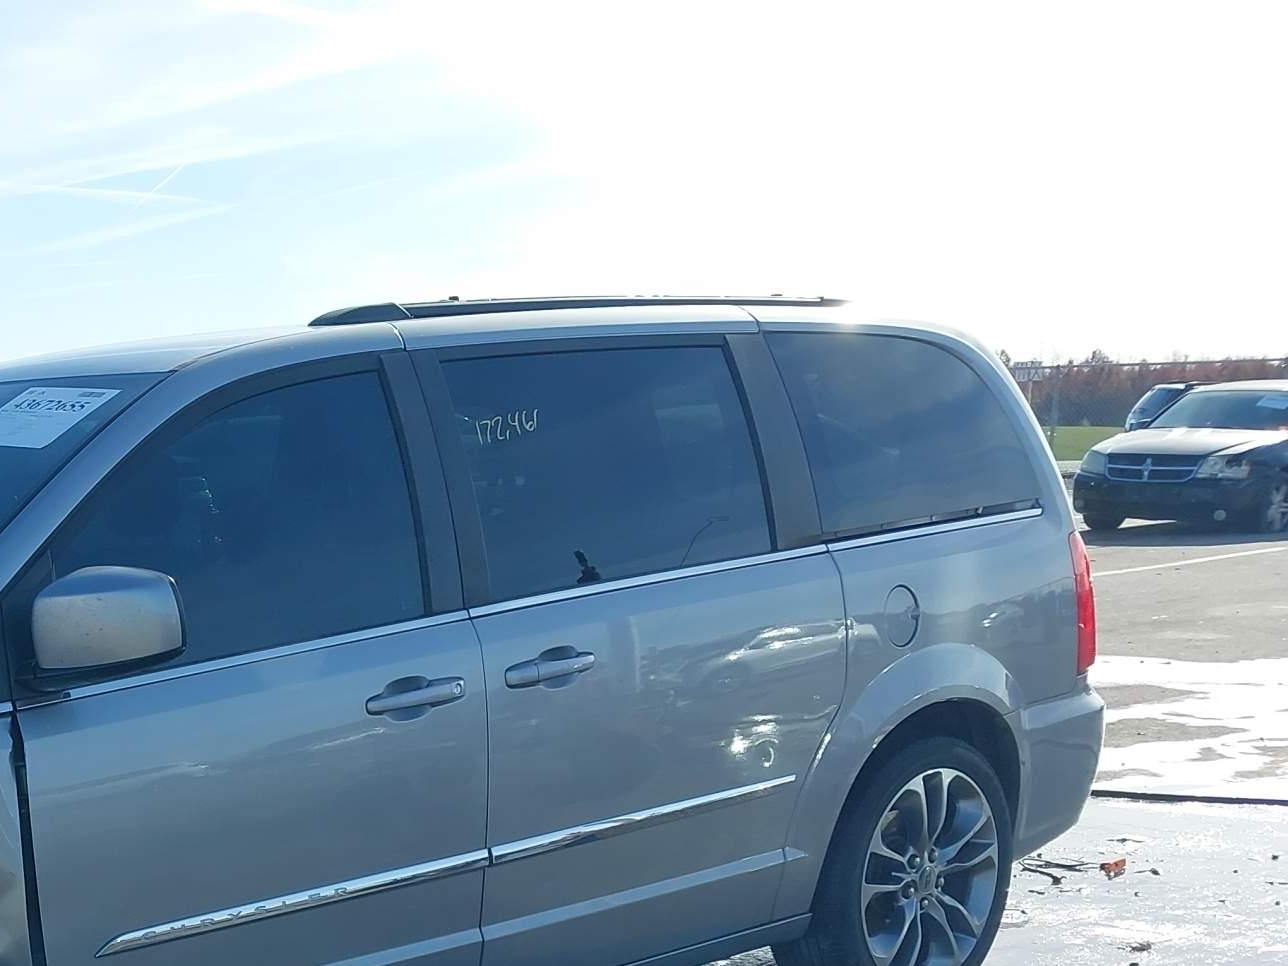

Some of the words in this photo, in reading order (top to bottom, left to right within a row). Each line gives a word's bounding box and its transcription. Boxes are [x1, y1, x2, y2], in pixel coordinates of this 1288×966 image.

[14, 398, 92, 412] 43672655
[475, 408, 539, 446] 172,461
[141, 886, 349, 940] CHRYSLER
